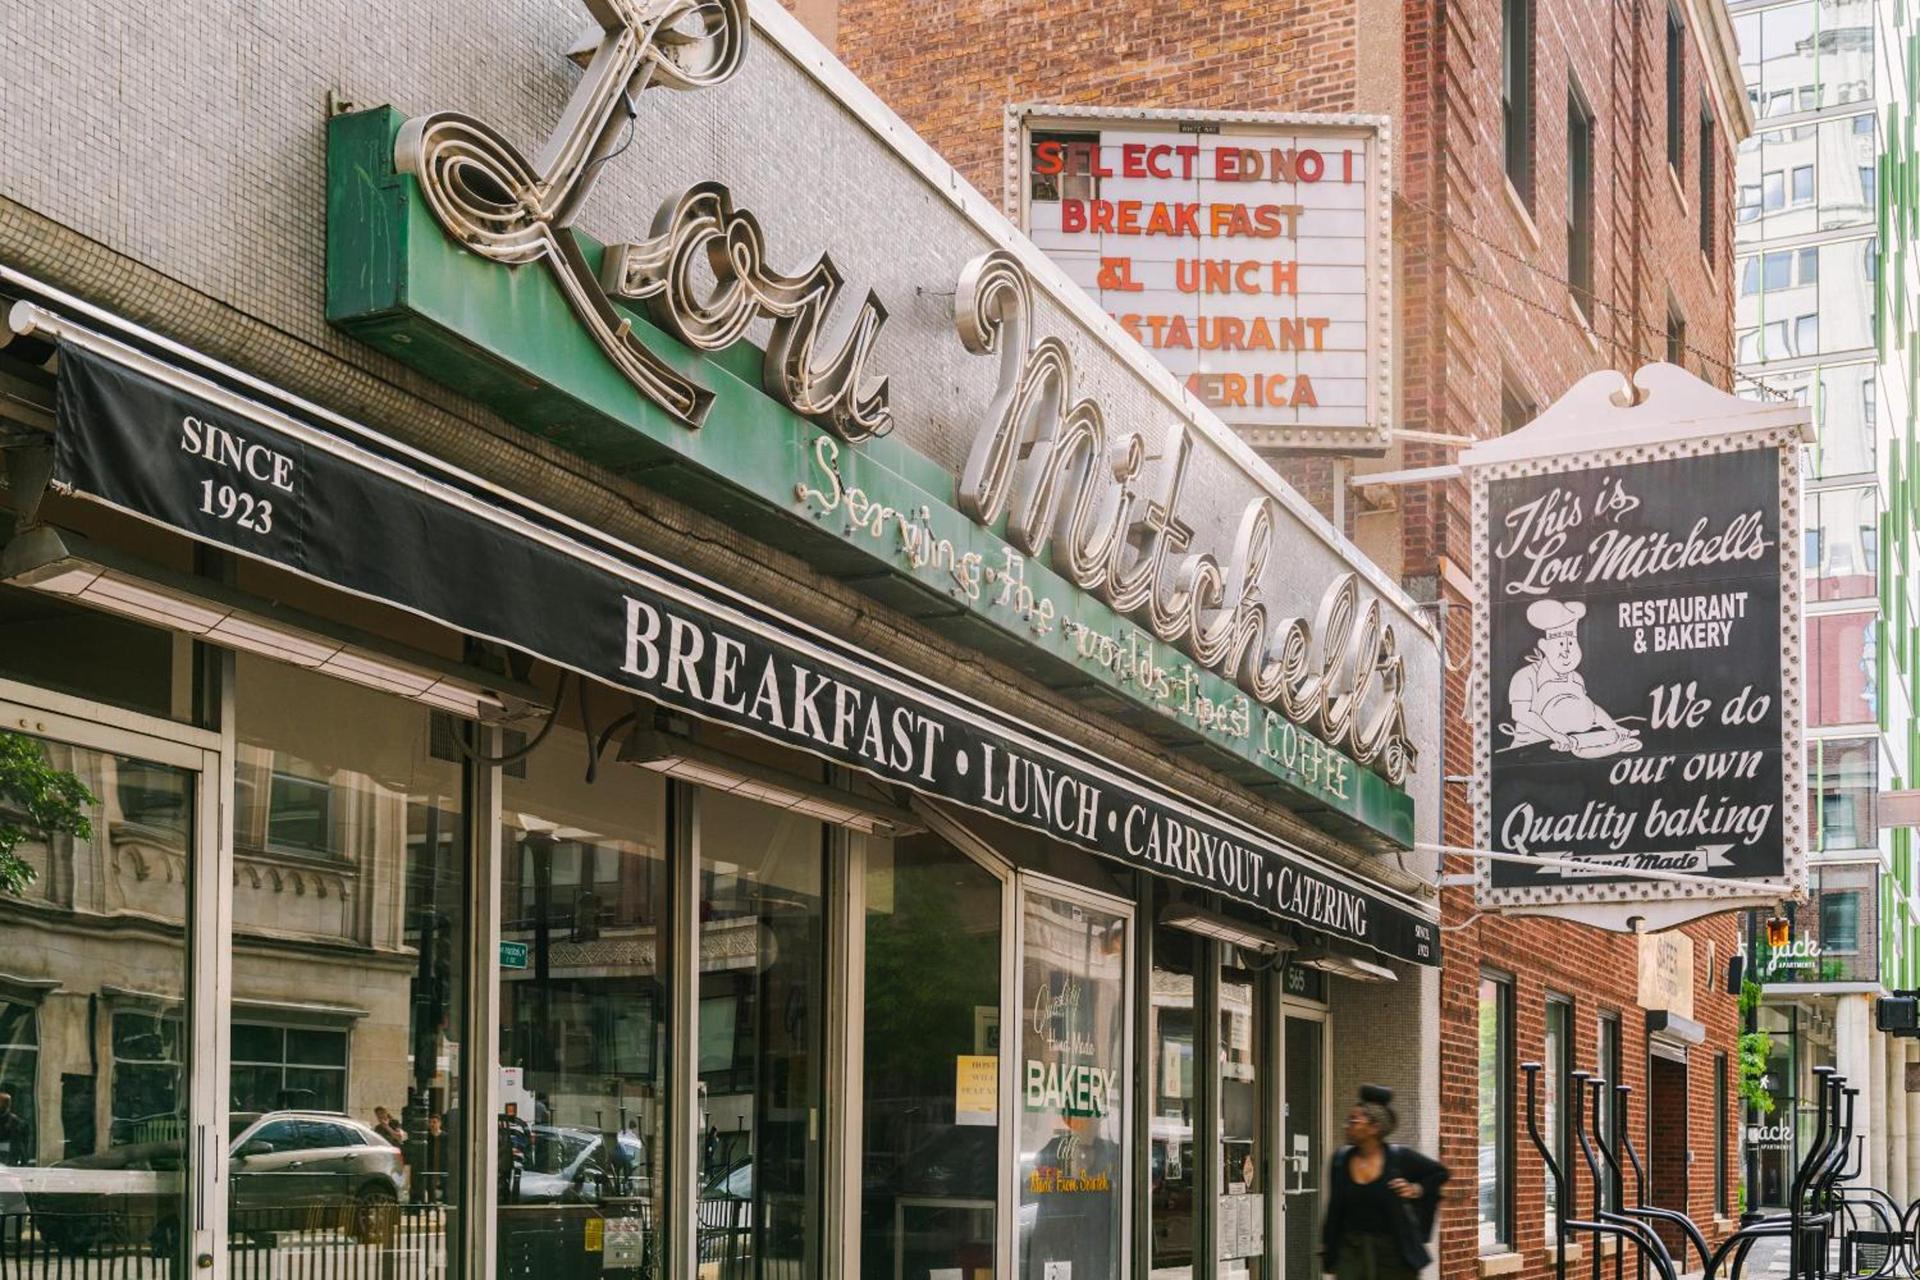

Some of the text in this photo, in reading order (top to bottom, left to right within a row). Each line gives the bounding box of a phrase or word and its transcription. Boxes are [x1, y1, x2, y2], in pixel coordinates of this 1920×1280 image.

[394, 0, 894, 443] Lou
[1108, 314, 1330, 352] STAURANT
[1184, 373, 1320, 408] ERICA
[181, 416, 295, 493] SINCE
[199, 478, 273, 535] 1923
[1496, 476, 1640, 559] This is
[1505, 510, 1774, 595] Lou Mitchells
[800, 436, 982, 600] Serving
[1264, 711, 1350, 800] COFFEE
[1619, 592, 1748, 628] RESTAURANT
[1634, 621, 1732, 653] & BAKERY
[1649, 680, 1771, 729] We do
[619, 594, 1368, 937] BREAKFAST LUNCH CARRYOUT CATERING
[1609, 750, 1764, 785] our own
[1501, 794, 1774, 856] Quality baking
[1633, 853, 1699, 870] Made
[1026, 1059, 1117, 1116] BAKERY
[1759, 1117, 1794, 1140] ack
